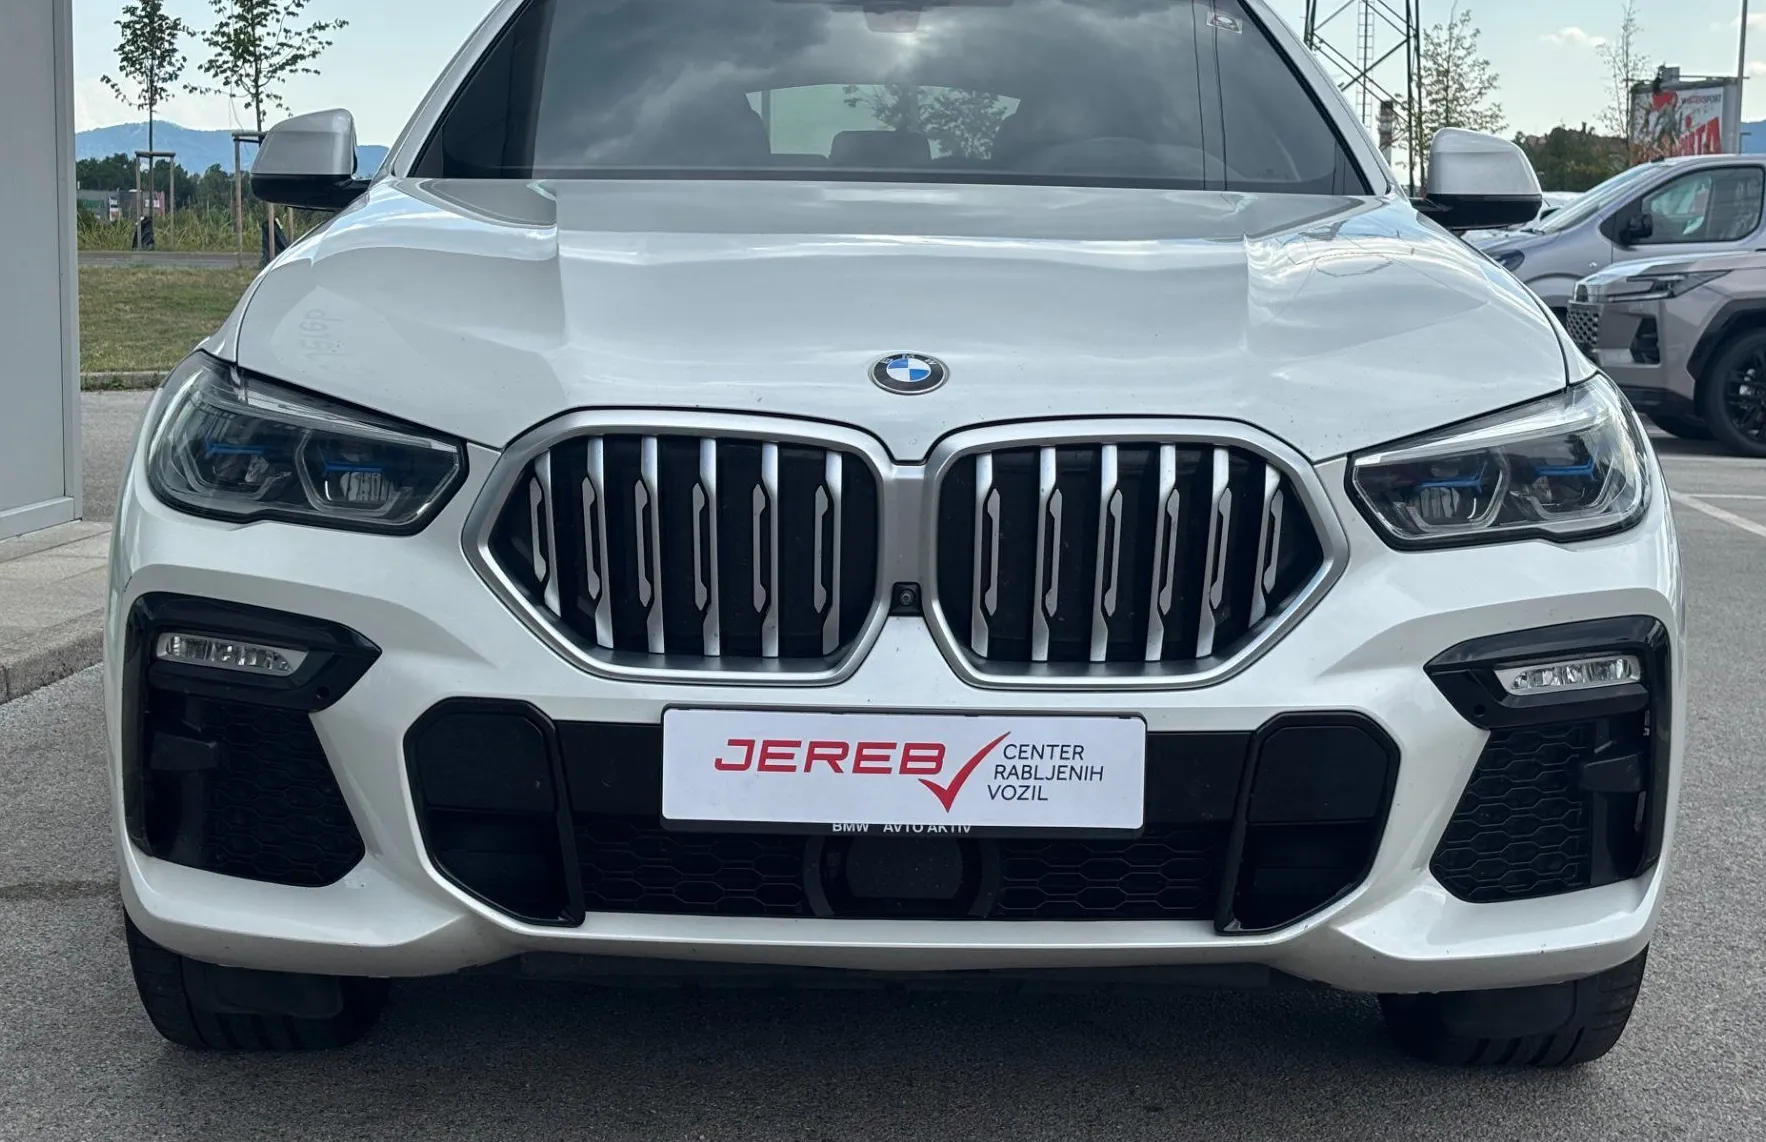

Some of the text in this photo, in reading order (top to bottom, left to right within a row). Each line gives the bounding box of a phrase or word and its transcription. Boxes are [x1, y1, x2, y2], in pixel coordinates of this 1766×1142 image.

[714, 738, 946, 775] JEREB
[1003, 743, 1085, 761] CENTER
[994, 764, 1104, 782] RABLJENIH
[987, 784, 1049, 801] VOZIL
[832, 822, 869, 832] BMW
